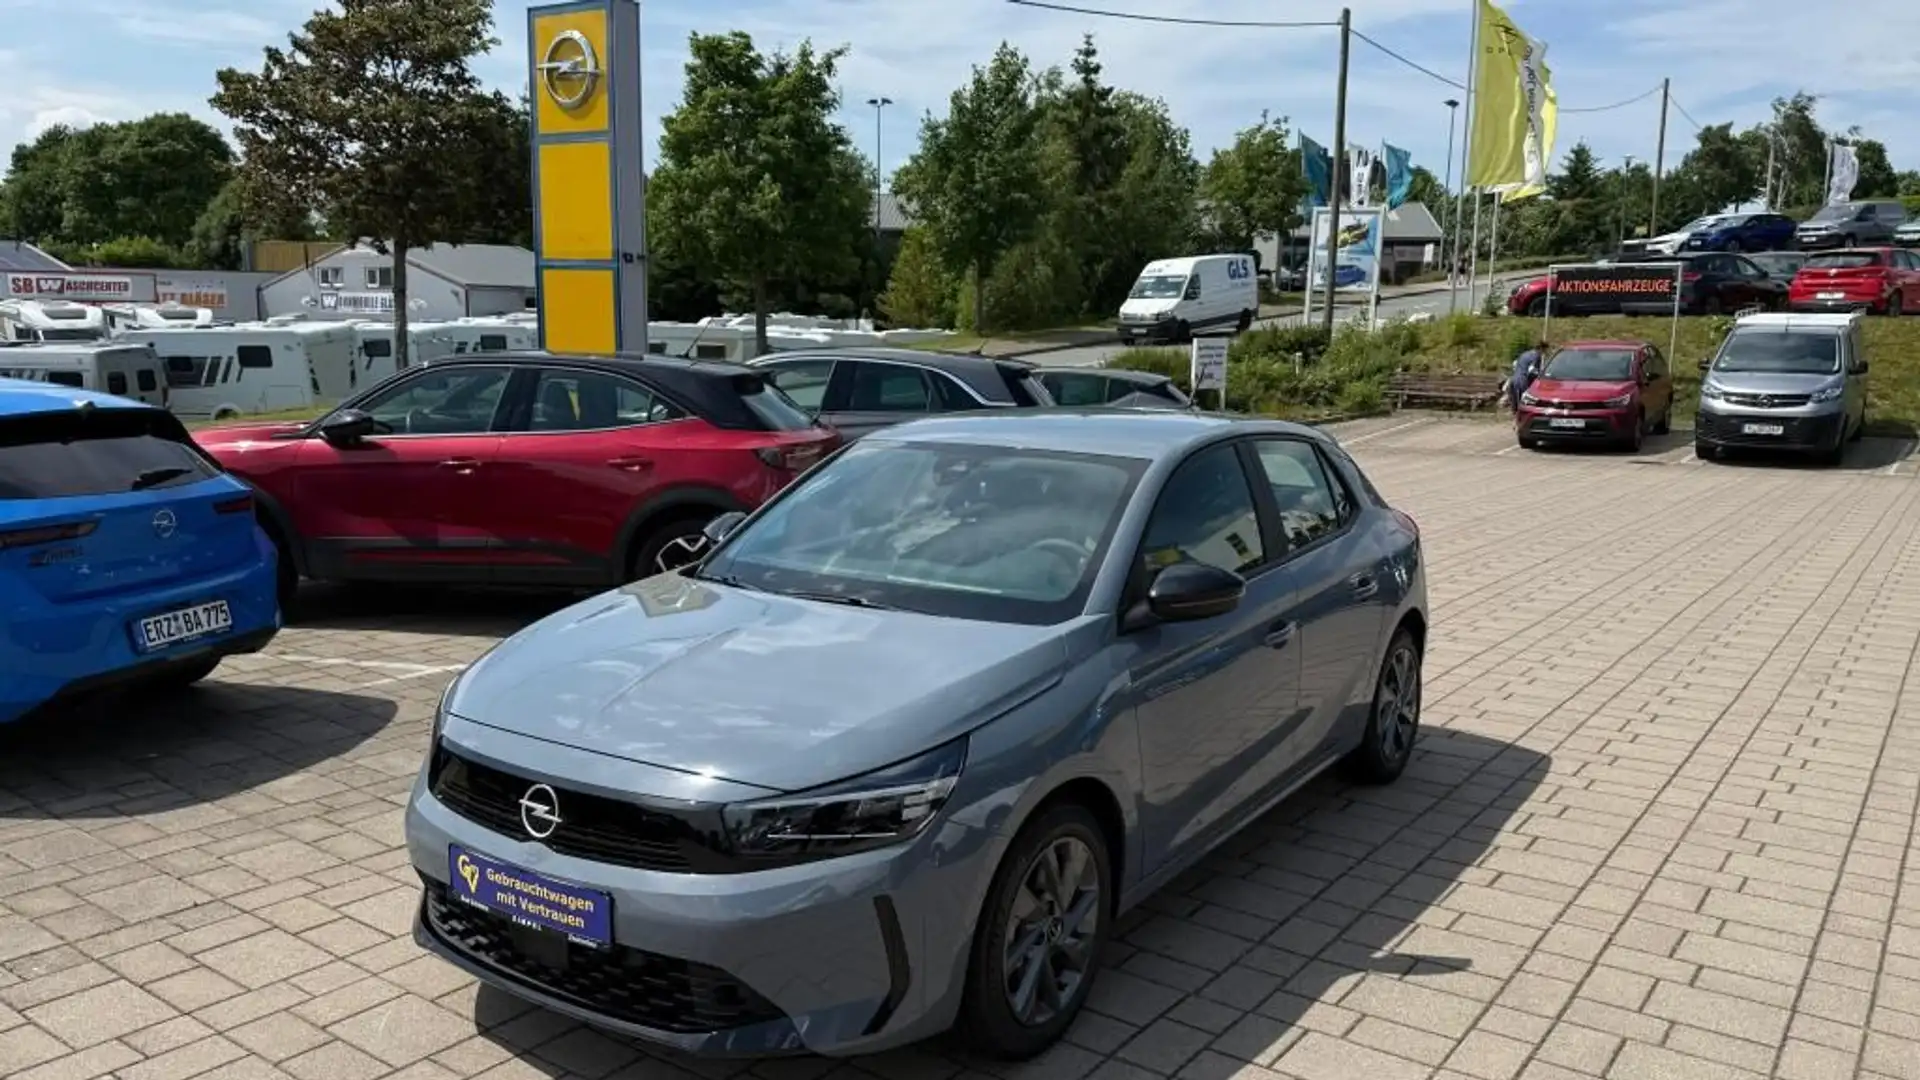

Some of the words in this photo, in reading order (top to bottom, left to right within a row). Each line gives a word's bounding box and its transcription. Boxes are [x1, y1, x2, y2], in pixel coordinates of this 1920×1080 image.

[1228, 259, 1249, 280] GLS
[11, 277, 34, 293] SB
[1558, 279, 1671, 293] AKTIONSFAHRZEUGE
[143, 617, 175, 643] ERZ
[182, 610, 205, 633] BA
[203, 603, 229, 628] 775
[486, 867, 594, 912] Gebrauchtwagen
[496, 890, 517, 907] mit
[519, 898, 585, 928] Vertrauen
